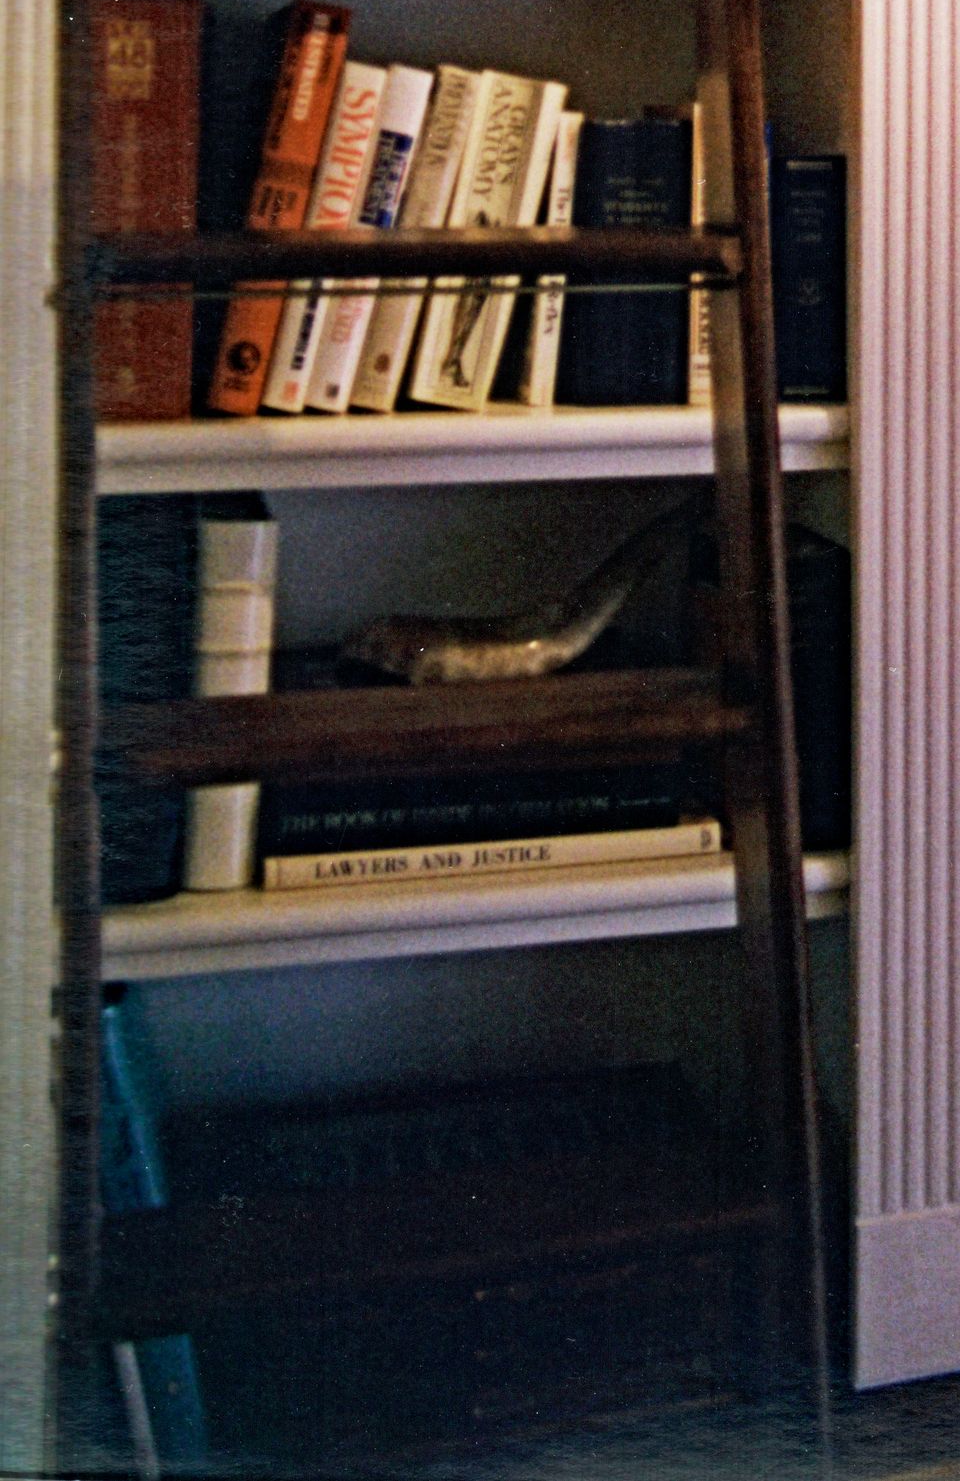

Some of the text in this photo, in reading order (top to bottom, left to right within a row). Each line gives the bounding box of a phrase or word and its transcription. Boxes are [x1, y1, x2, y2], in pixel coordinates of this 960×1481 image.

[472, 88, 513, 196] ANATOMY
[314, 845, 552, 881] LAWYERS AND JUSTICE
